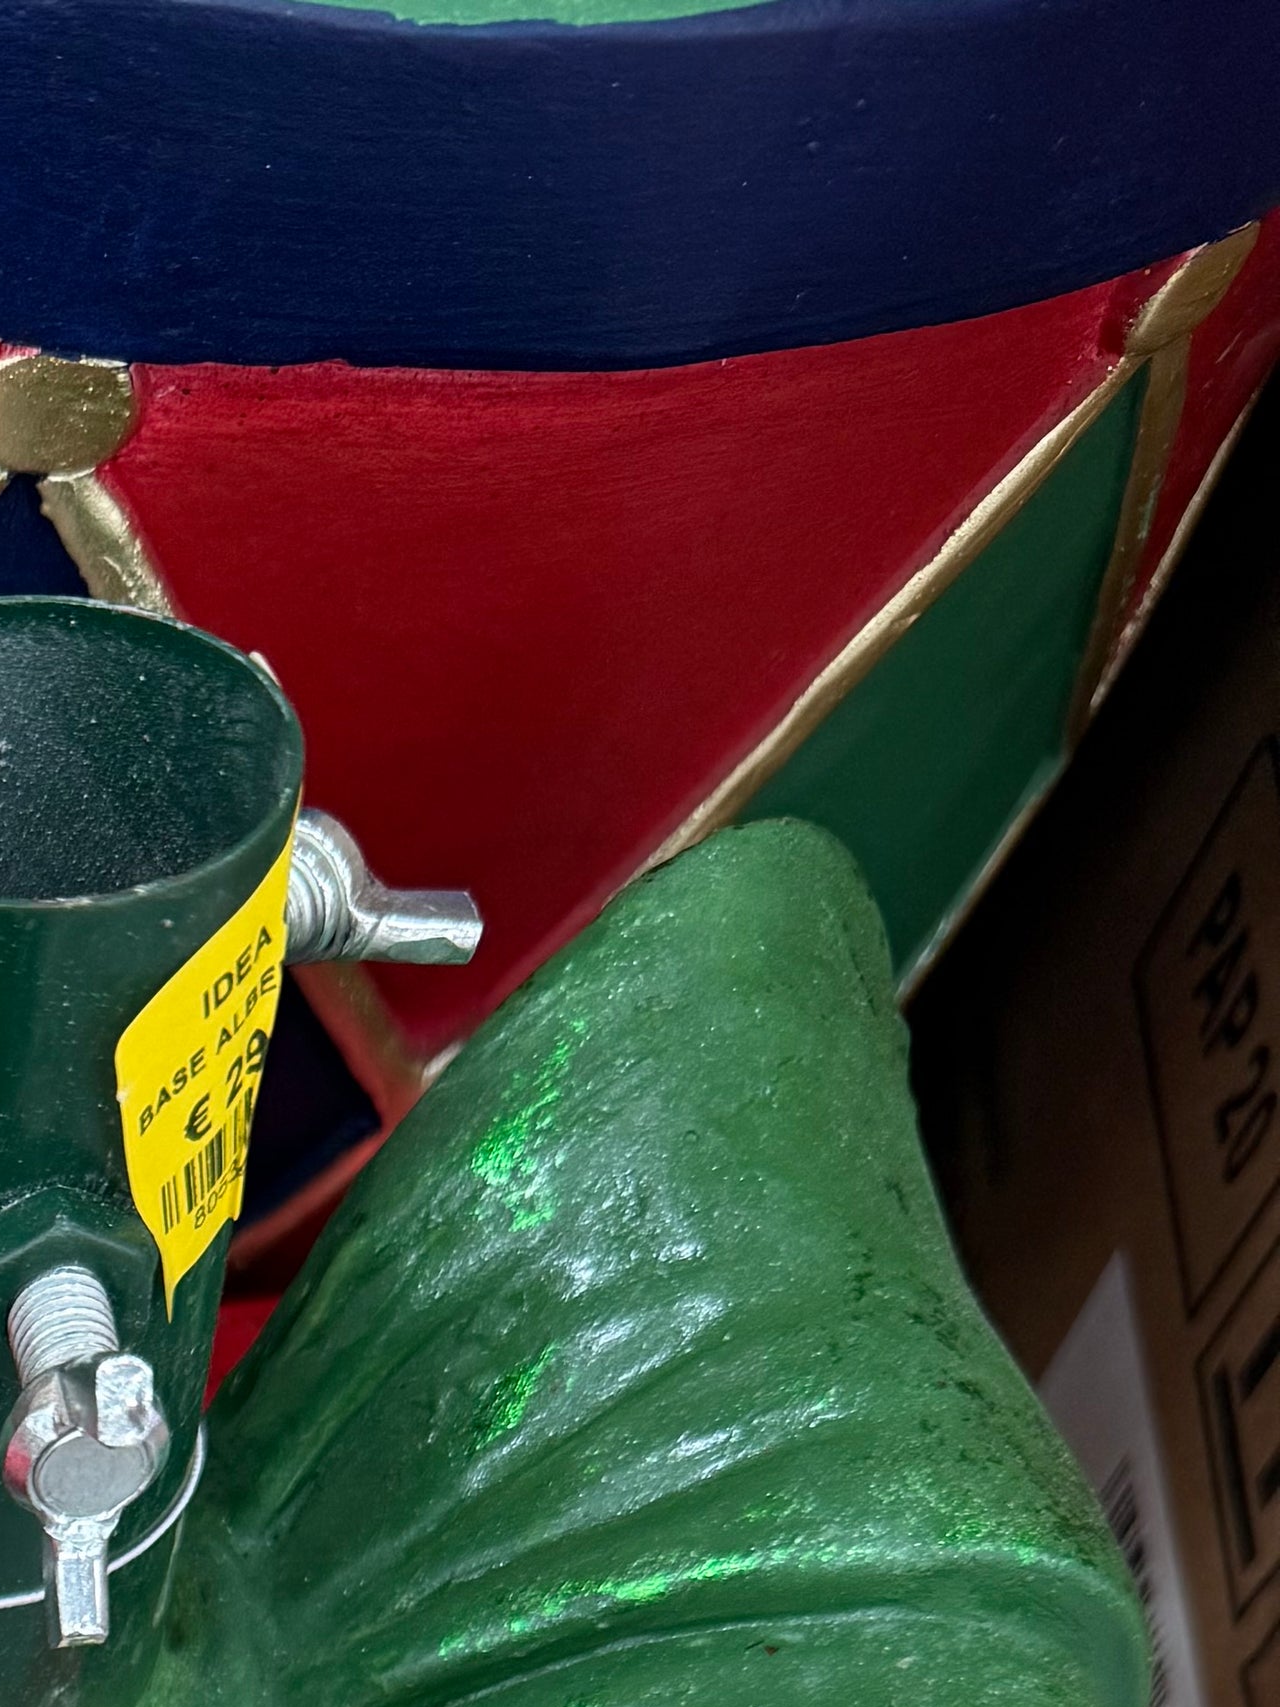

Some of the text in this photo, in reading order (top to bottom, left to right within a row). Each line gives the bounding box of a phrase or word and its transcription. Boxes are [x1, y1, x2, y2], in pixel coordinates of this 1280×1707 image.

[202, 925, 272, 1020] IDEA
[1187, 868, 1278, 1184] PAP 20
[140, 1046, 207, 1137] BASE
[183, 1092, 213, 1142] €
[194, 1157, 245, 1230] 8053
